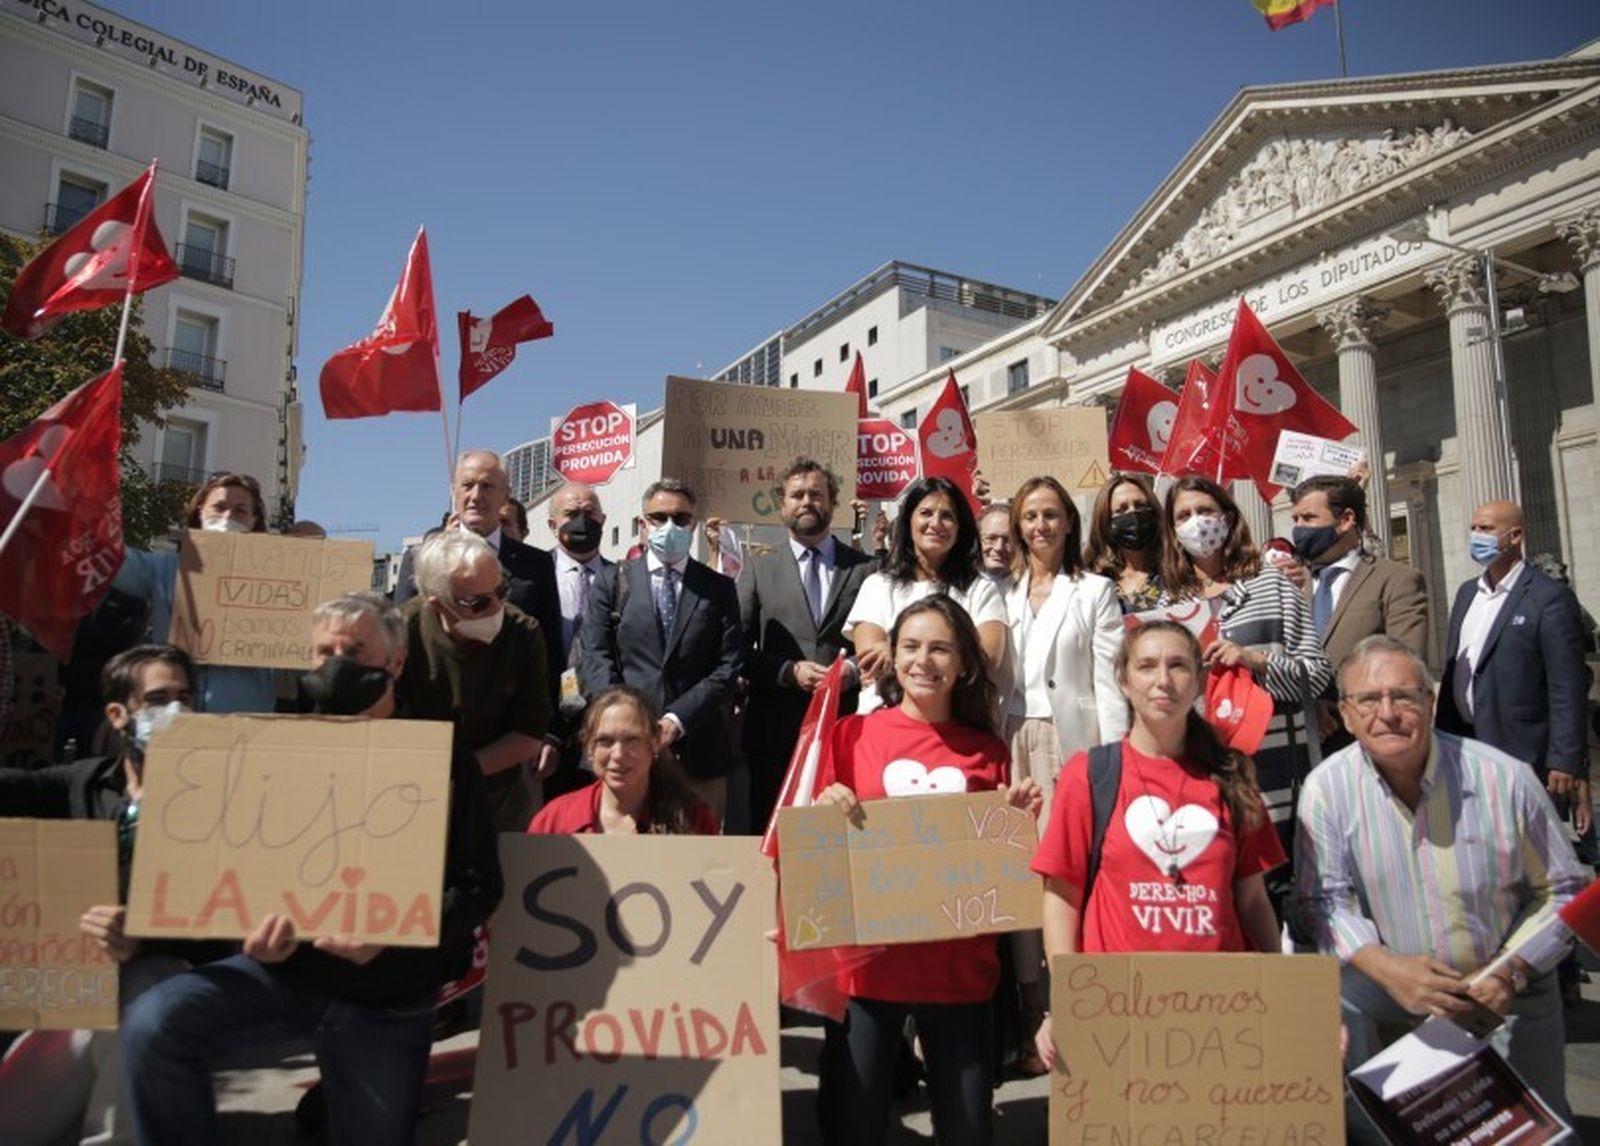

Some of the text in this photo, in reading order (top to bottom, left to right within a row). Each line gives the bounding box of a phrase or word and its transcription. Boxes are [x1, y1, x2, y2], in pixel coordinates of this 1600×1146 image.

[76, 13, 178, 65] COLEGIAL
[183, 55, 208, 77] DE
[216, 69, 282, 109] ESPAÑA
[1279, 280, 1309, 305] LOS
[562, 412, 624, 442] STOP
[711, 427, 765, 451] UNA
[858, 432, 907, 455] TOP
[992, 414, 1063, 440] STOP
[555, 433, 630, 456] PERSECUCIÓN
[560, 450, 624, 472] PROVIDA
[739, 466, 750, 484] A
[857, 470, 911, 485] ROVIDA
[160, 733, 438, 888] Elijo
[967, 805, 1030, 852] VOZ
[148, 868, 251, 931] LA
[1129, 881, 1218, 903] DERECHO A
[514, 866, 746, 972] SOY
[941, 888, 1016, 931] VOZ
[1131, 904, 1217, 936] VIVIR
[1068, 964, 1268, 1020] Salvamos
[1091, 1027, 1265, 1069] VIDAS
[546, 1084, 699, 1146] NO
[1060, 1077, 1091, 1123] y
[1123, 1077, 1191, 1106] nos
[1468, 1109, 1514, 1143] mujeres
